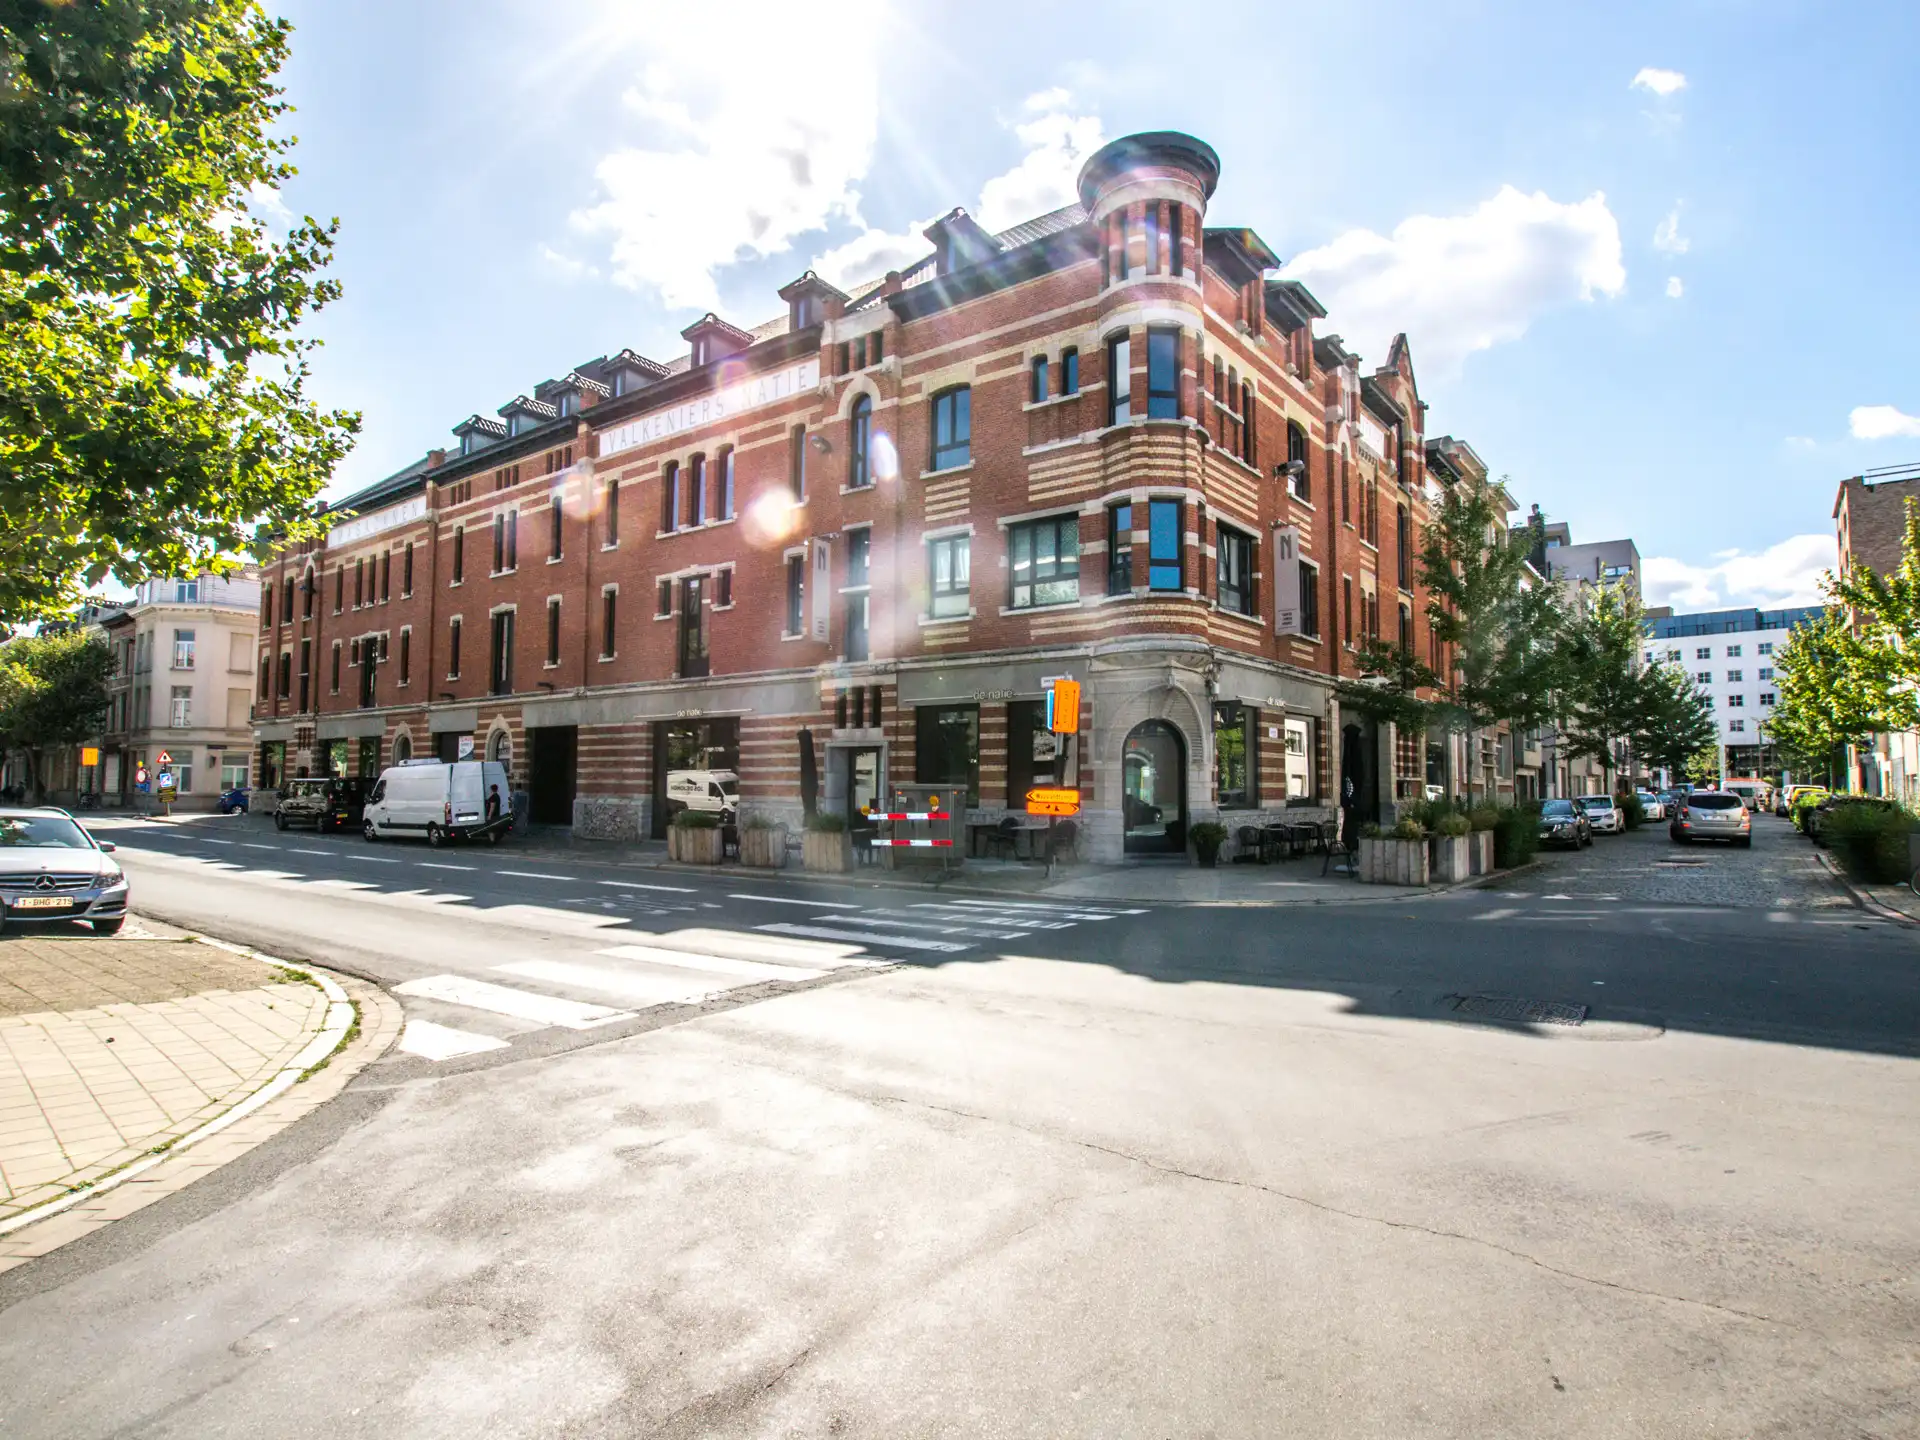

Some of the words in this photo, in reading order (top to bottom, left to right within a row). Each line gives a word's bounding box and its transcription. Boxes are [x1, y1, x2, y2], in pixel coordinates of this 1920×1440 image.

[607, 397, 724, 451] VALKENIERS
[817, 545, 827, 571] N
[1280, 534, 1292, 560] N
[973, 688, 985, 700] de
[988, 688, 1013, 699] natie
